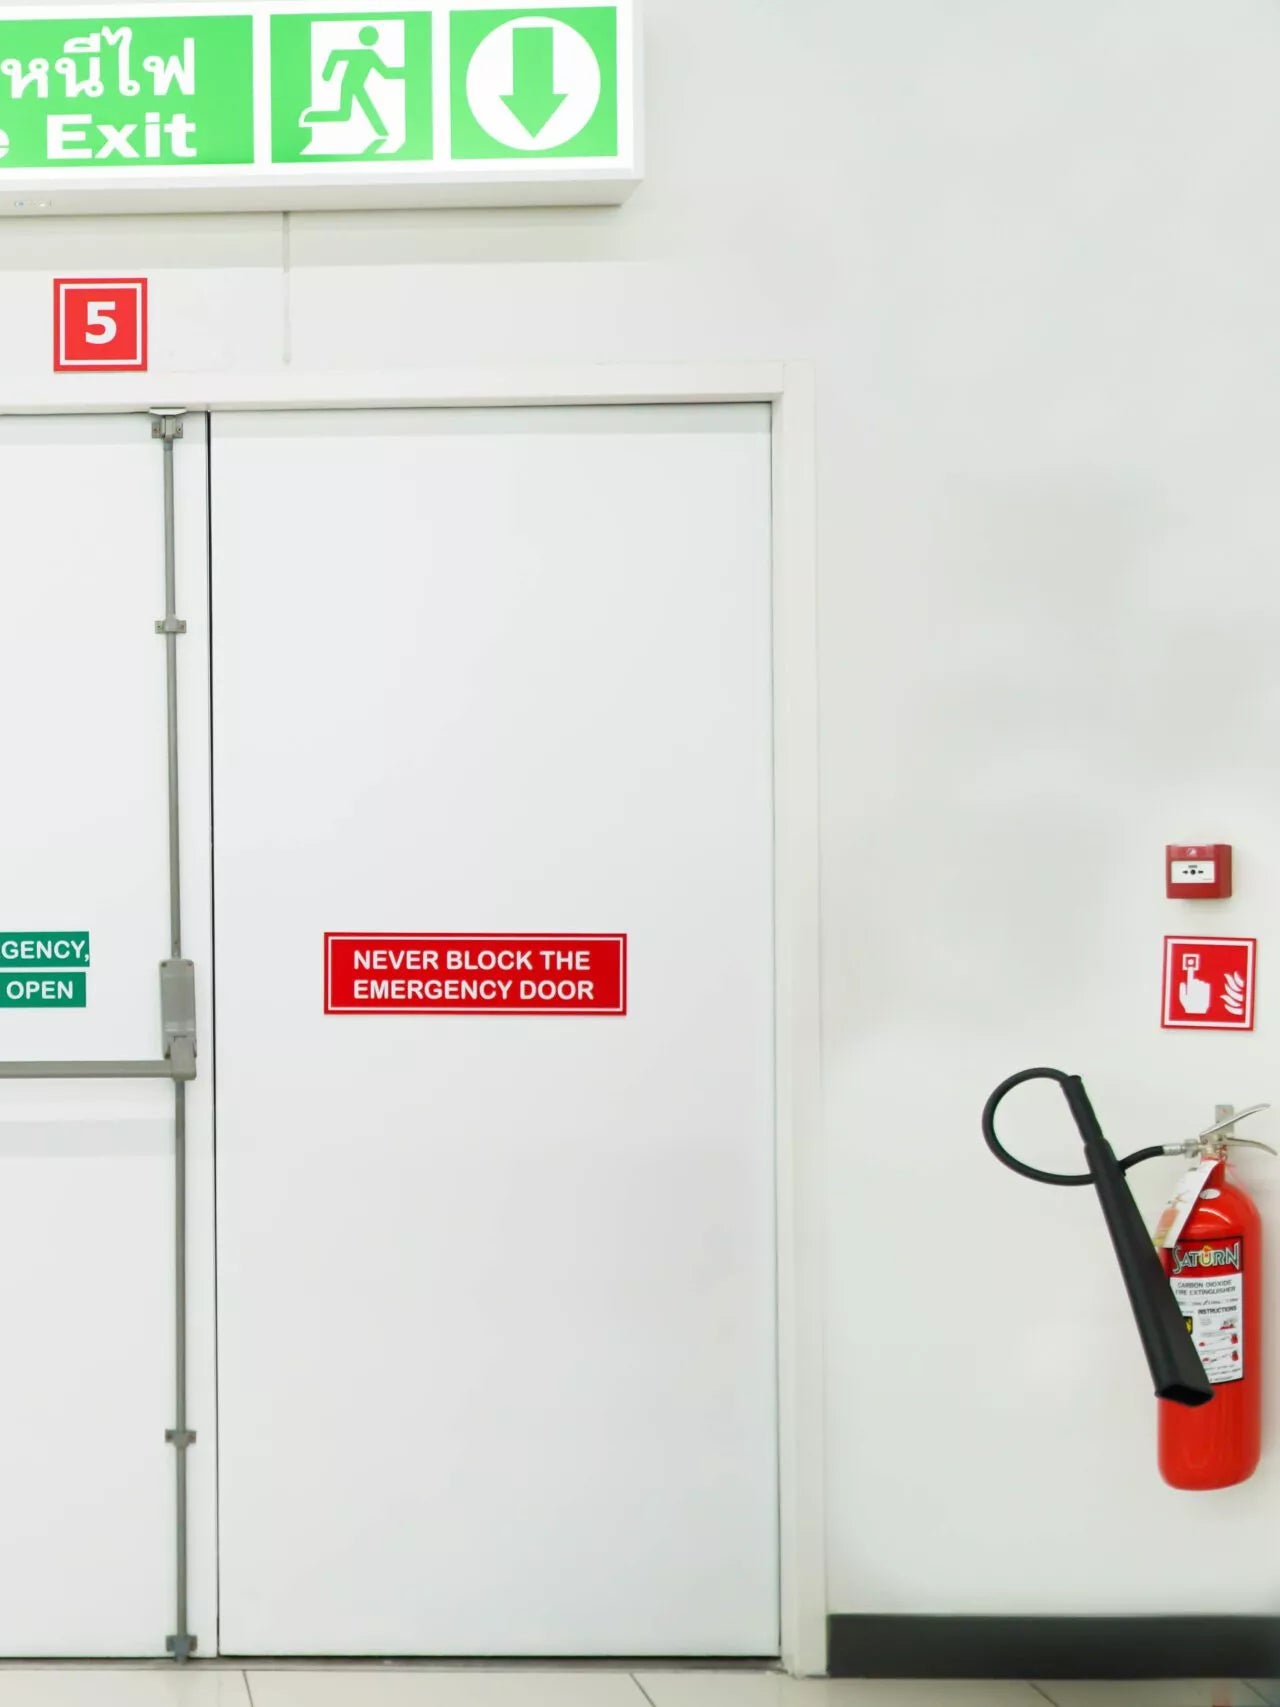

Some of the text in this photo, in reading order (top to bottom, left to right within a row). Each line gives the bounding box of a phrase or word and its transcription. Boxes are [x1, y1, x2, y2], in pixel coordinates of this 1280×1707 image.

[46, 112, 197, 160] Exit
[85, 301, 117, 345] 5
[353, 949, 591, 971] NEVER BLOCK THE
[6, 980, 74, 1000] OPEN
[353, 979, 594, 1000] EMERGENCY DOOR
[1172, 1242, 1240, 1274] SATURN
